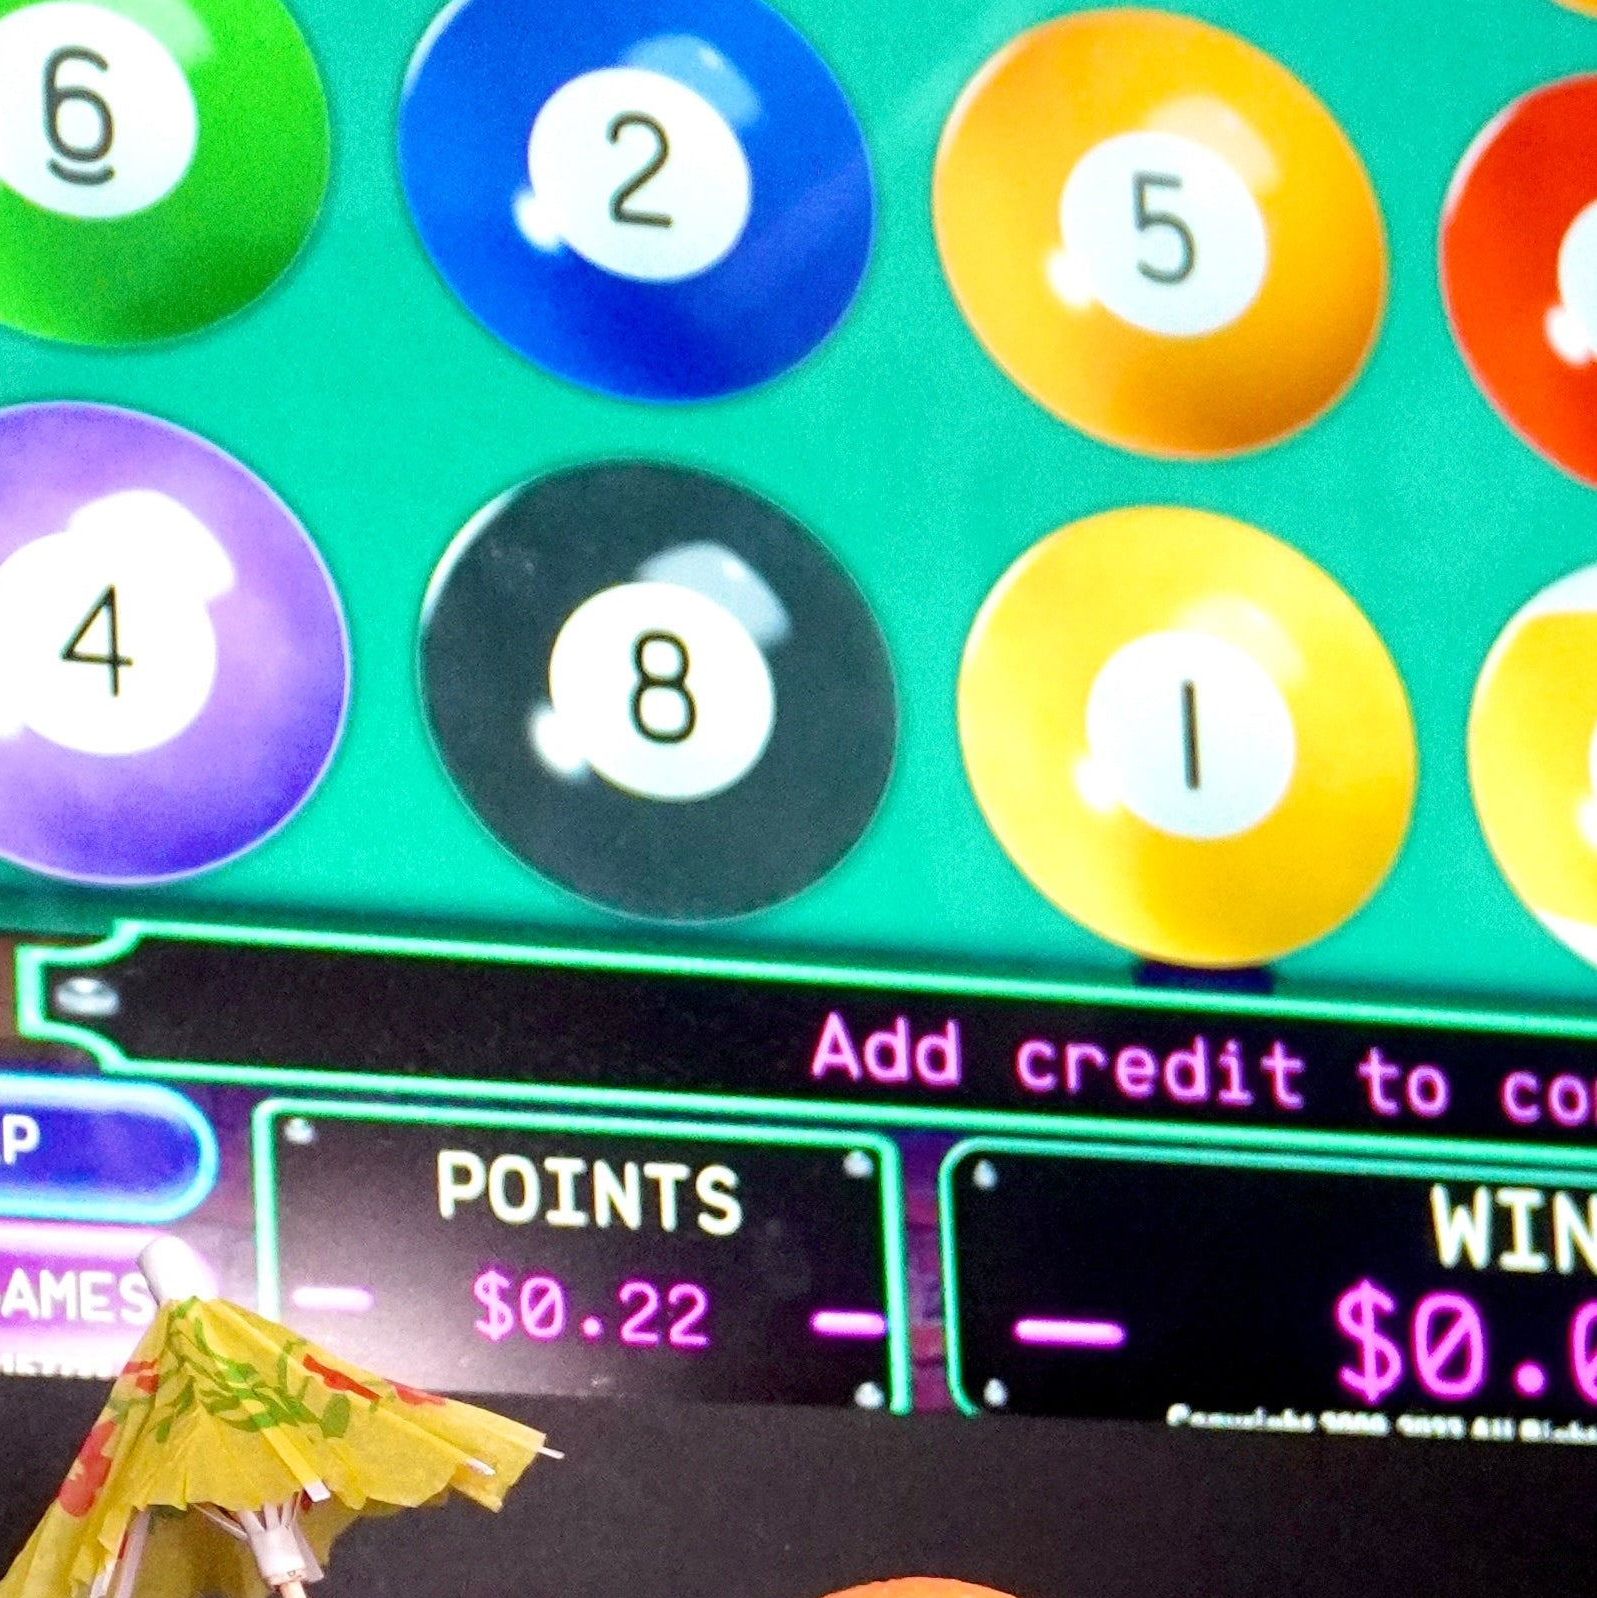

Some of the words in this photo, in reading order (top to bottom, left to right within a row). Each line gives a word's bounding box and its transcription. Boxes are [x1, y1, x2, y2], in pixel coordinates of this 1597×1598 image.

[43, 45, 116, 186] 6
[606, 111, 674, 229] 2
[1132, 172, 1195, 285] 5
[61, 585, 133, 697] 4
[630, 630, 697, 745] 8
[811, 1012, 962, 1086] Add
[1016, 1036, 1304, 1110] credit
[1357, 1048, 1448, 1117] to
[1501, 1071, 1597, 1127] co
[436, 1149, 743, 1235] POINTS
[474, 1270, 709, 1346] $0.22
